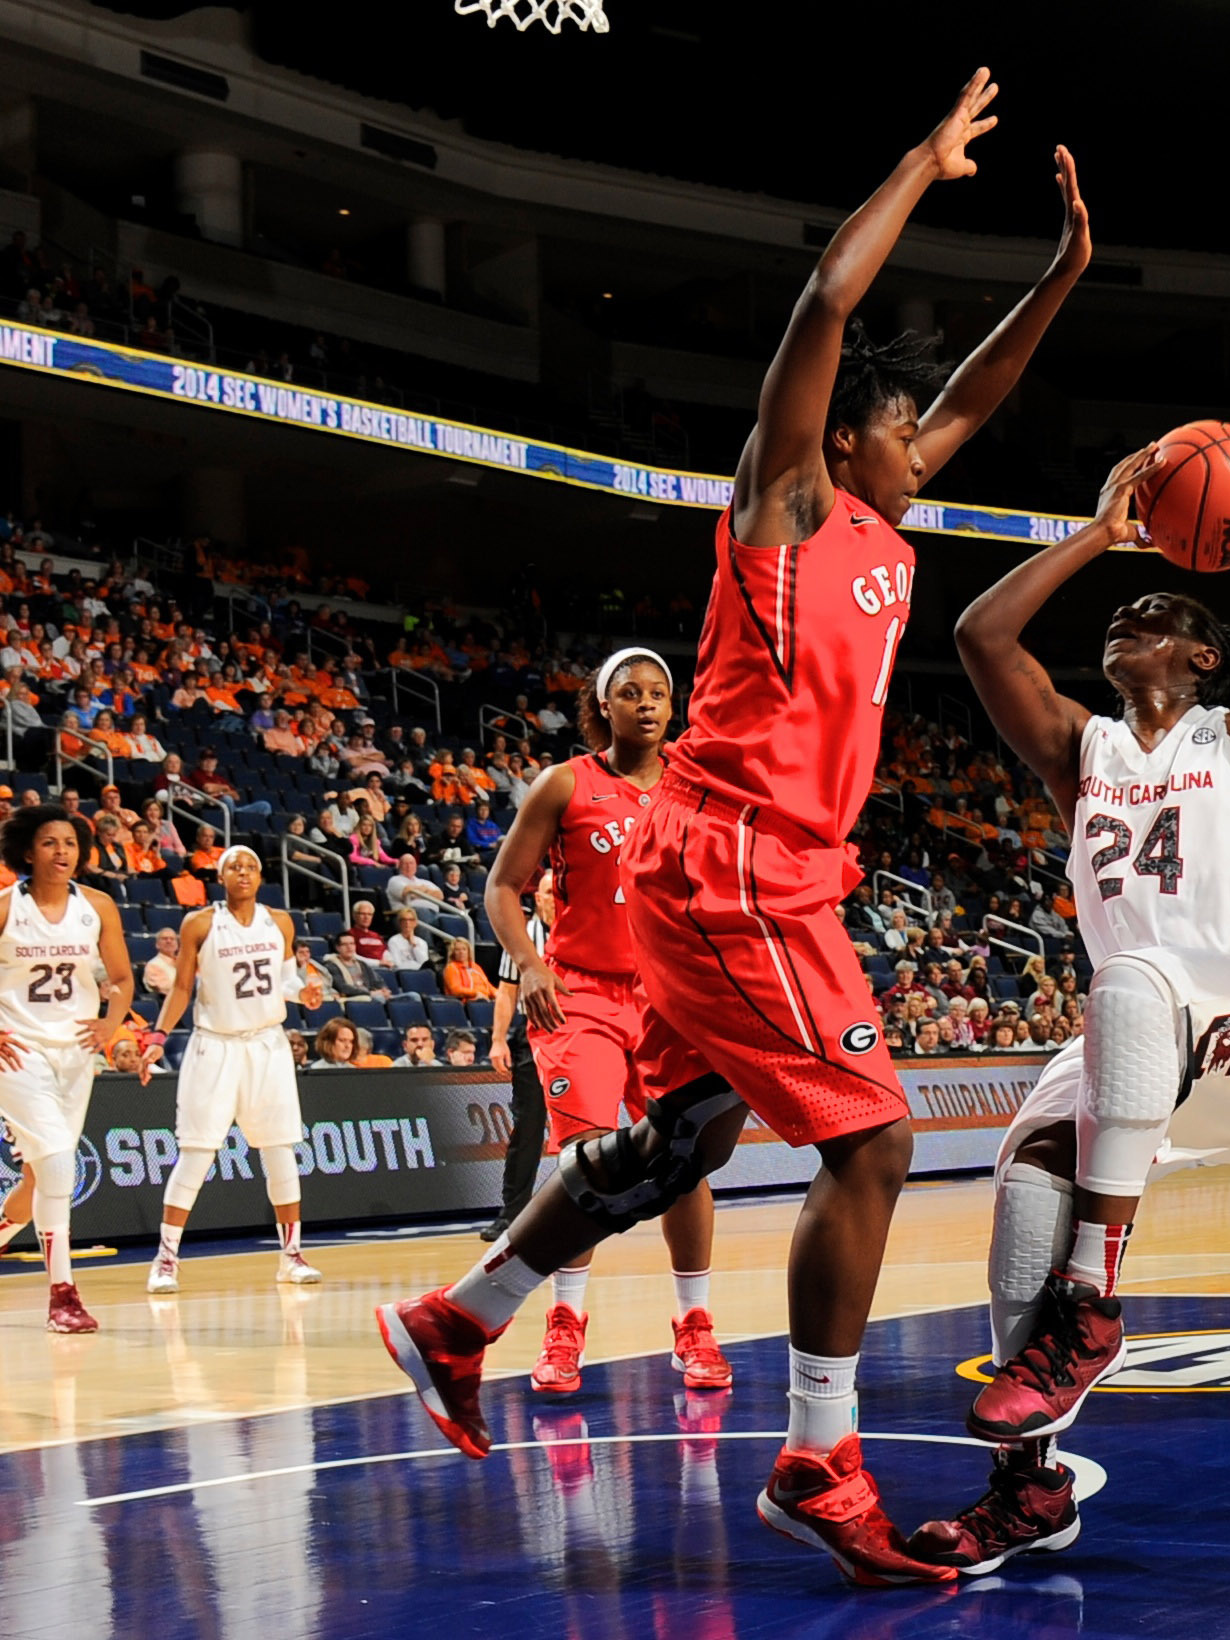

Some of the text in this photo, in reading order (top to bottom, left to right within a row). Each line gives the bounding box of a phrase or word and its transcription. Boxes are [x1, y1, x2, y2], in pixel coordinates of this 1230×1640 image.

[172, 365, 528, 469] 2014 SEC WOMEN'S BASKETBALL TOURNAMENT
[613, 463, 734, 506] 2014 SEC WOME
[1029, 516, 1066, 542] 2014
[871, 616, 906, 707] 1
[1128, 769, 1214, 807] CARLINA
[1085, 805, 1184, 902] 24
[15, 945, 47, 958] SOUTH
[28, 962, 76, 1003] 23
[232, 957, 273, 1000] 25
[466, 1102, 514, 1144] 20
[105, 1117, 436, 1188] SPRSOUTH
